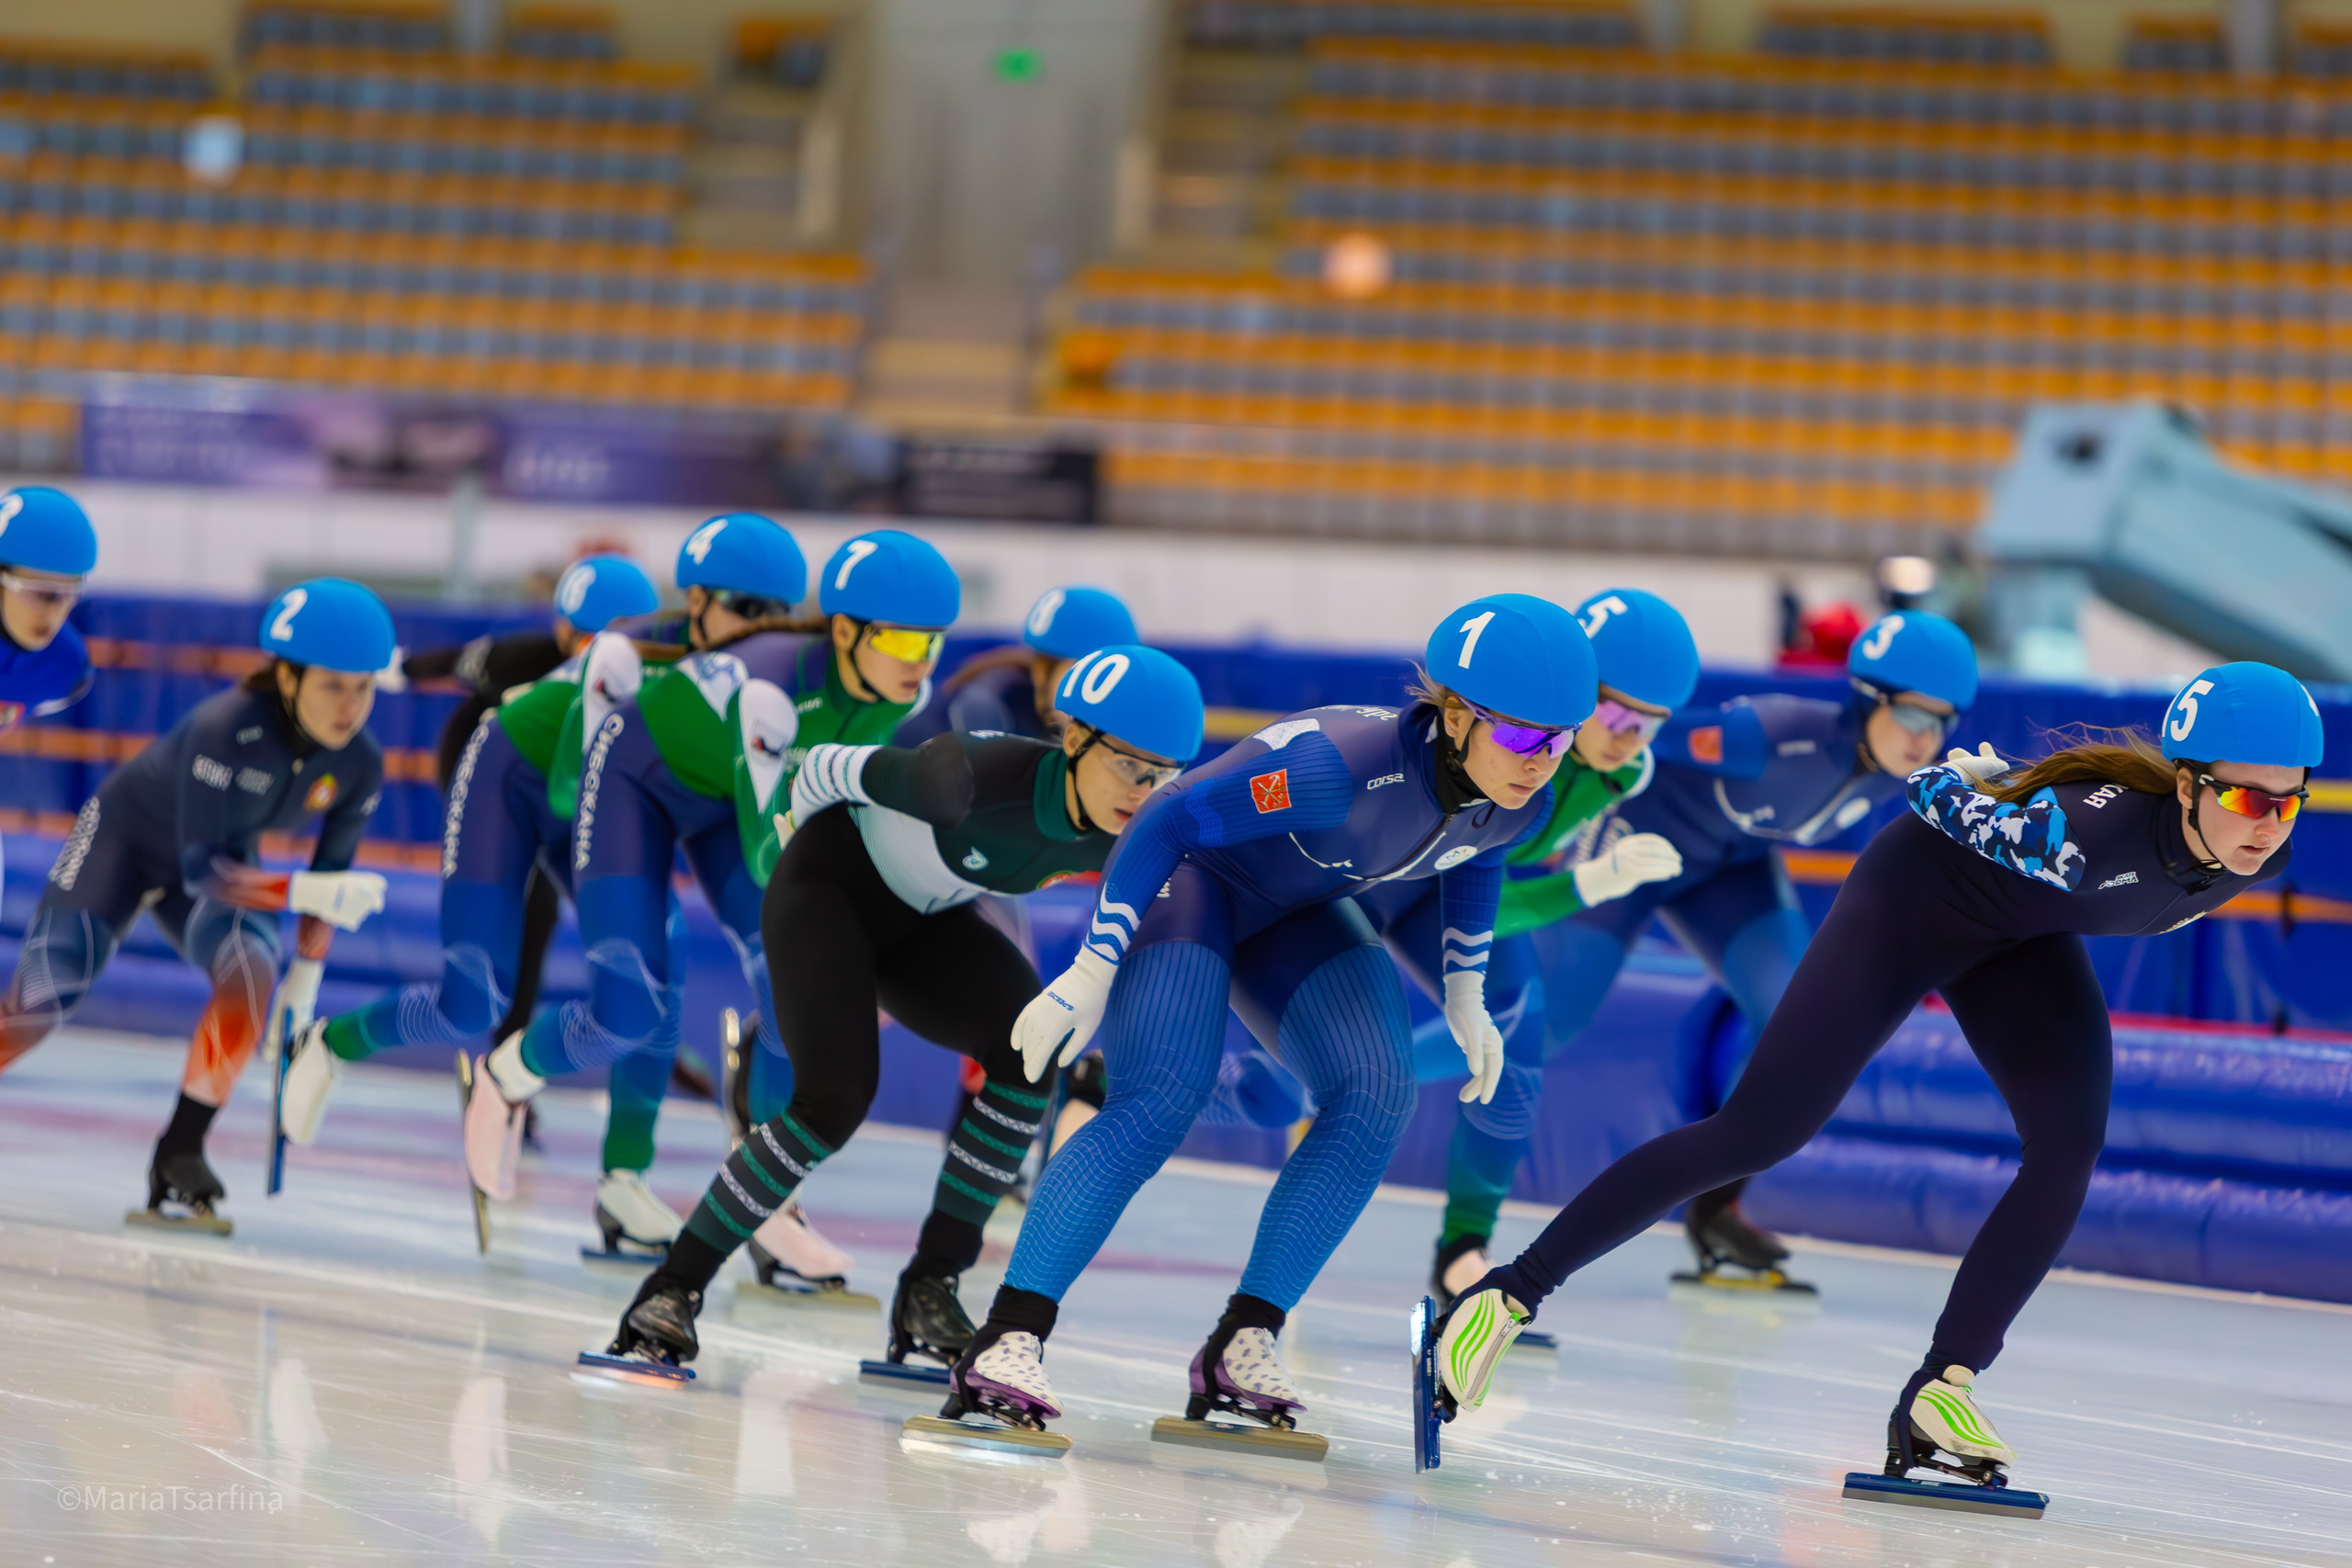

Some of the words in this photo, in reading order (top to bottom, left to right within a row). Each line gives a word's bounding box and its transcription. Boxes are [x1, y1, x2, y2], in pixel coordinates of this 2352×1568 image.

[686, 518, 729, 565] 4
[834, 539, 878, 591] 7
[270, 588, 308, 642] 2
[1458, 611, 1497, 670] 1
[1862, 615, 1905, 660] 3
[1062, 649, 1131, 705] 10
